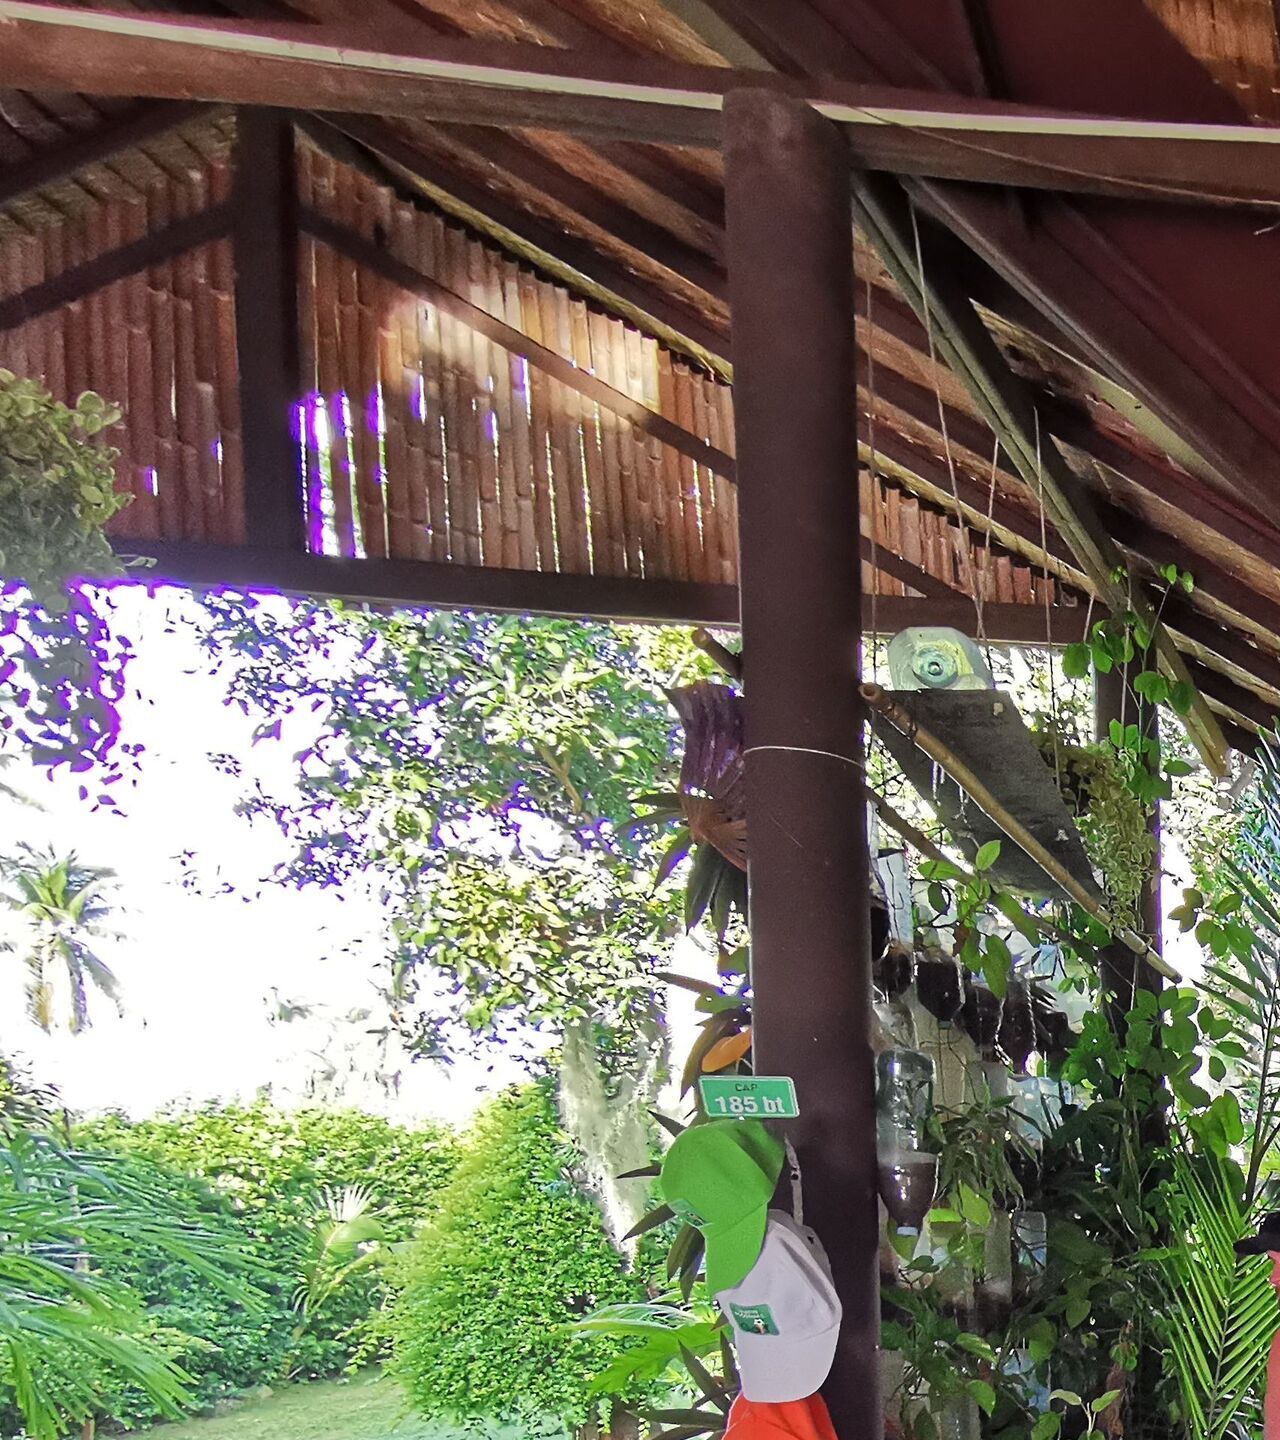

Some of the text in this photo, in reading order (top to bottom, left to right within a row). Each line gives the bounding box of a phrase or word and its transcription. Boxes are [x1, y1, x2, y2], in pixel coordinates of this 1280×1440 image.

[734, 1083, 758, 1091] CAP
[714, 1096, 785, 1113] 185 bt
